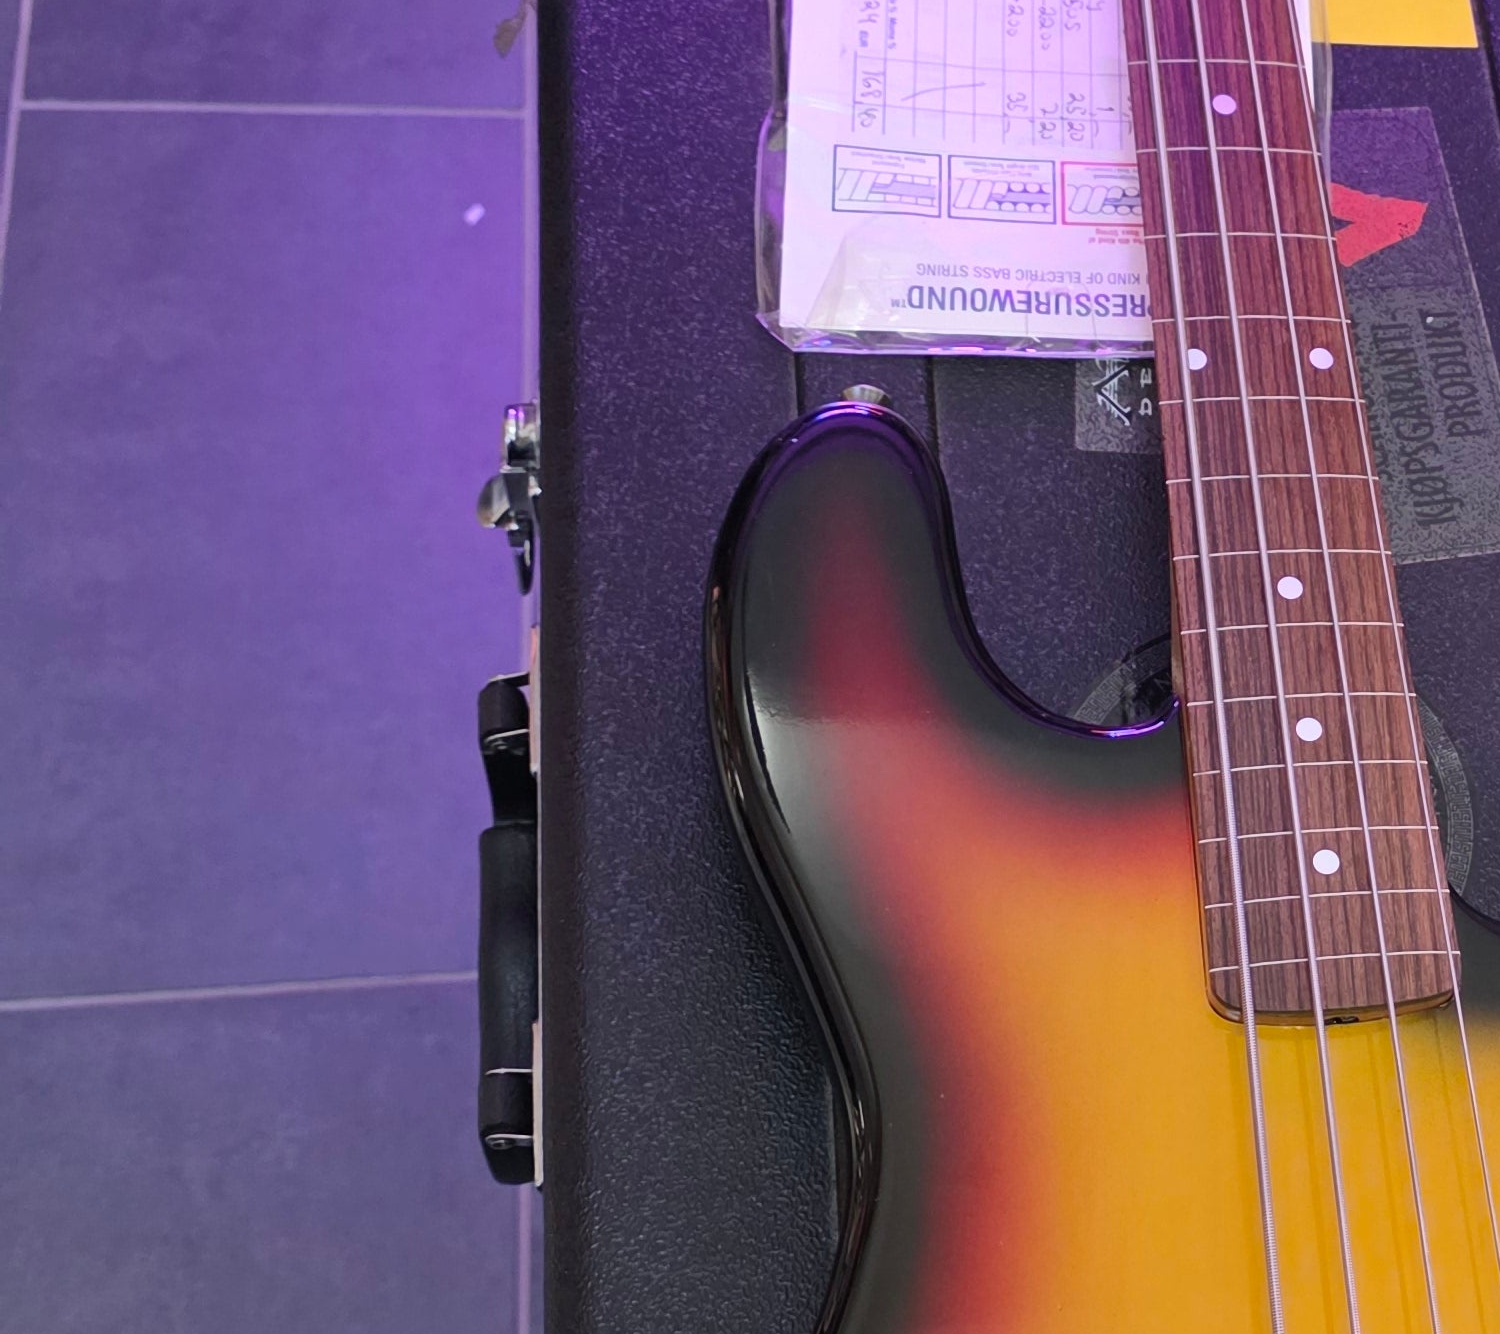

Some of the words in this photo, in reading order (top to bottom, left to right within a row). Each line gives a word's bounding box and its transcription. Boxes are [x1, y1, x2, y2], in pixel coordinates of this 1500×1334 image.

[916, 263, 969, 277] STRING
[974, 265, 1010, 280] BASS
[1016, 267, 1082, 284] ELECTRIC
[1087, 270, 1104, 284] OF
[1107, 271, 1141, 285] KIND
[1417, 307, 1488, 439] PRODUKT
